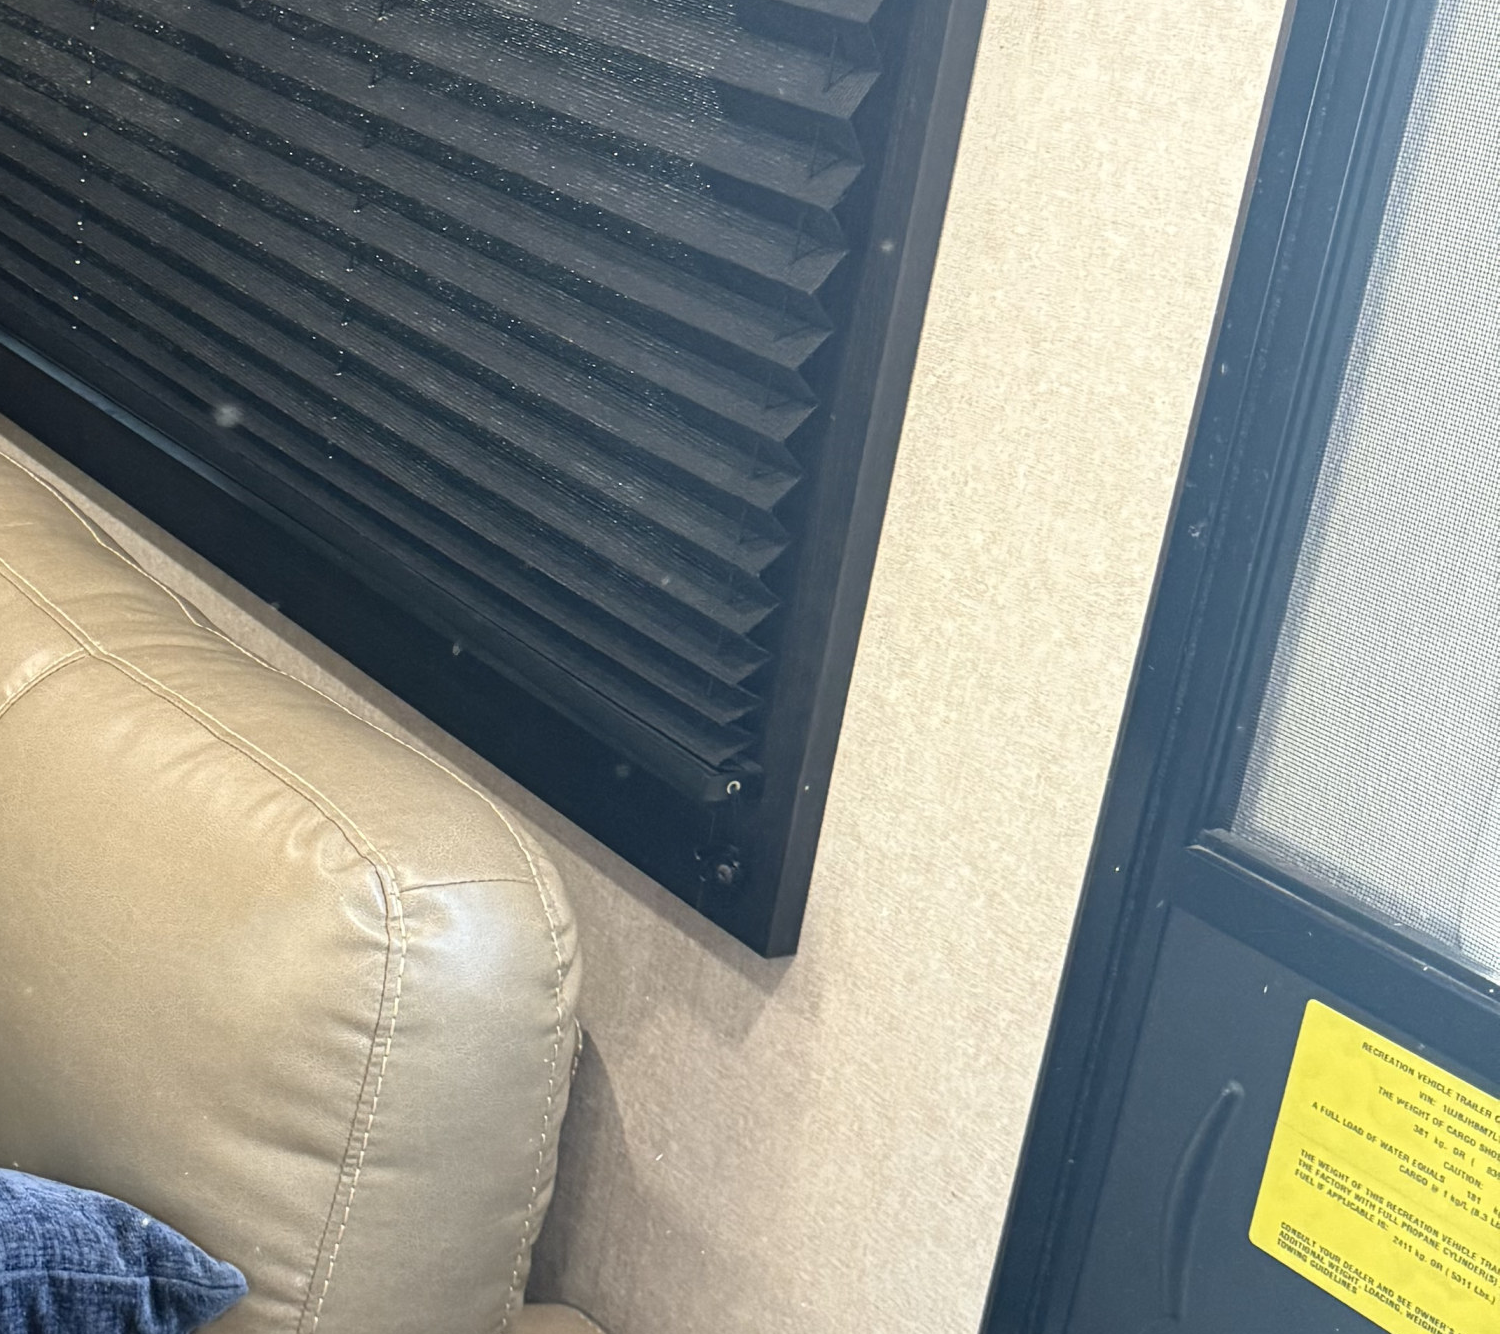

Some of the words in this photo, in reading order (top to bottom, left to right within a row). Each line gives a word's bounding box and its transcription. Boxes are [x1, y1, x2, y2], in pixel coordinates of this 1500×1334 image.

[1362, 1042, 1414, 1076] RECREATION
[1418, 1072, 1453, 1097] VEHICLE
[1456, 1092, 1492, 1118] TRAILER
[1419, 1091, 1436, 1106] VIN:
[1312, 1101, 1318, 1110] A
[1320, 1105, 1340, 1123] FULL
[1342, 1118, 1364, 1136] LOAD
[1366, 1132, 1377, 1143] OF
[1380, 1140, 1410, 1163] WATER
[1412, 1158, 1445, 1183] EQUALS
[1379, 1086, 1393, 1101] THE
[1397, 1097, 1430, 1121] WEIGHT
[1432, 1117, 1444, 1128] OF
[1446, 1125, 1476, 1147] CARGO
[1399, 1164, 1428, 1186] CARGO
[1444, 1161, 1483, 1190] CAUTION:
[1453, 1147, 1465, 1160] OR
[1294, 1168, 1315, 1187] FUEL
[1317, 1182, 1325, 1190] IF
[1326, 1188, 1375, 1223] APPLICABLE
[1377, 1219, 1388, 1231] IS:
[1298, 1158, 1313, 1173] THE
[1315, 1168, 1352, 1195] FACTORY
[1354, 1192, 1376, 1211] WITH
[1377, 1207, 1398, 1225] FULL
[1401, 1221, 1440, 1251] PROPANE
[1442, 1247, 1497, 1286] CYLINDER(S)
[1301, 1148, 1315, 1163] THE
[1318, 1159, 1350, 1183] WEIGHT
[1351, 1180, 1362, 1190] OF
[1366, 1187, 1384, 1205] THIS
[1386, 1201, 1439, 1238] RECREATION
[1441, 1233, 1476, 1261] VEHICLE
[1277, 1237, 1308, 1263] TOWING
[1309, 1259, 1358, 1294] GUIDELINES
[1278, 1230, 1326, 1264] ADDITIONAL
[1280, 1221, 1316, 1247] CONSULT
[1319, 1245, 1341, 1263] YOUR
[1342, 1260, 1375, 1286] DEALER
[1376, 1282, 1395, 1298] AND
[1396, 1295, 1412, 1310] SEE
[1430, 1259, 1443, 1271] OR
